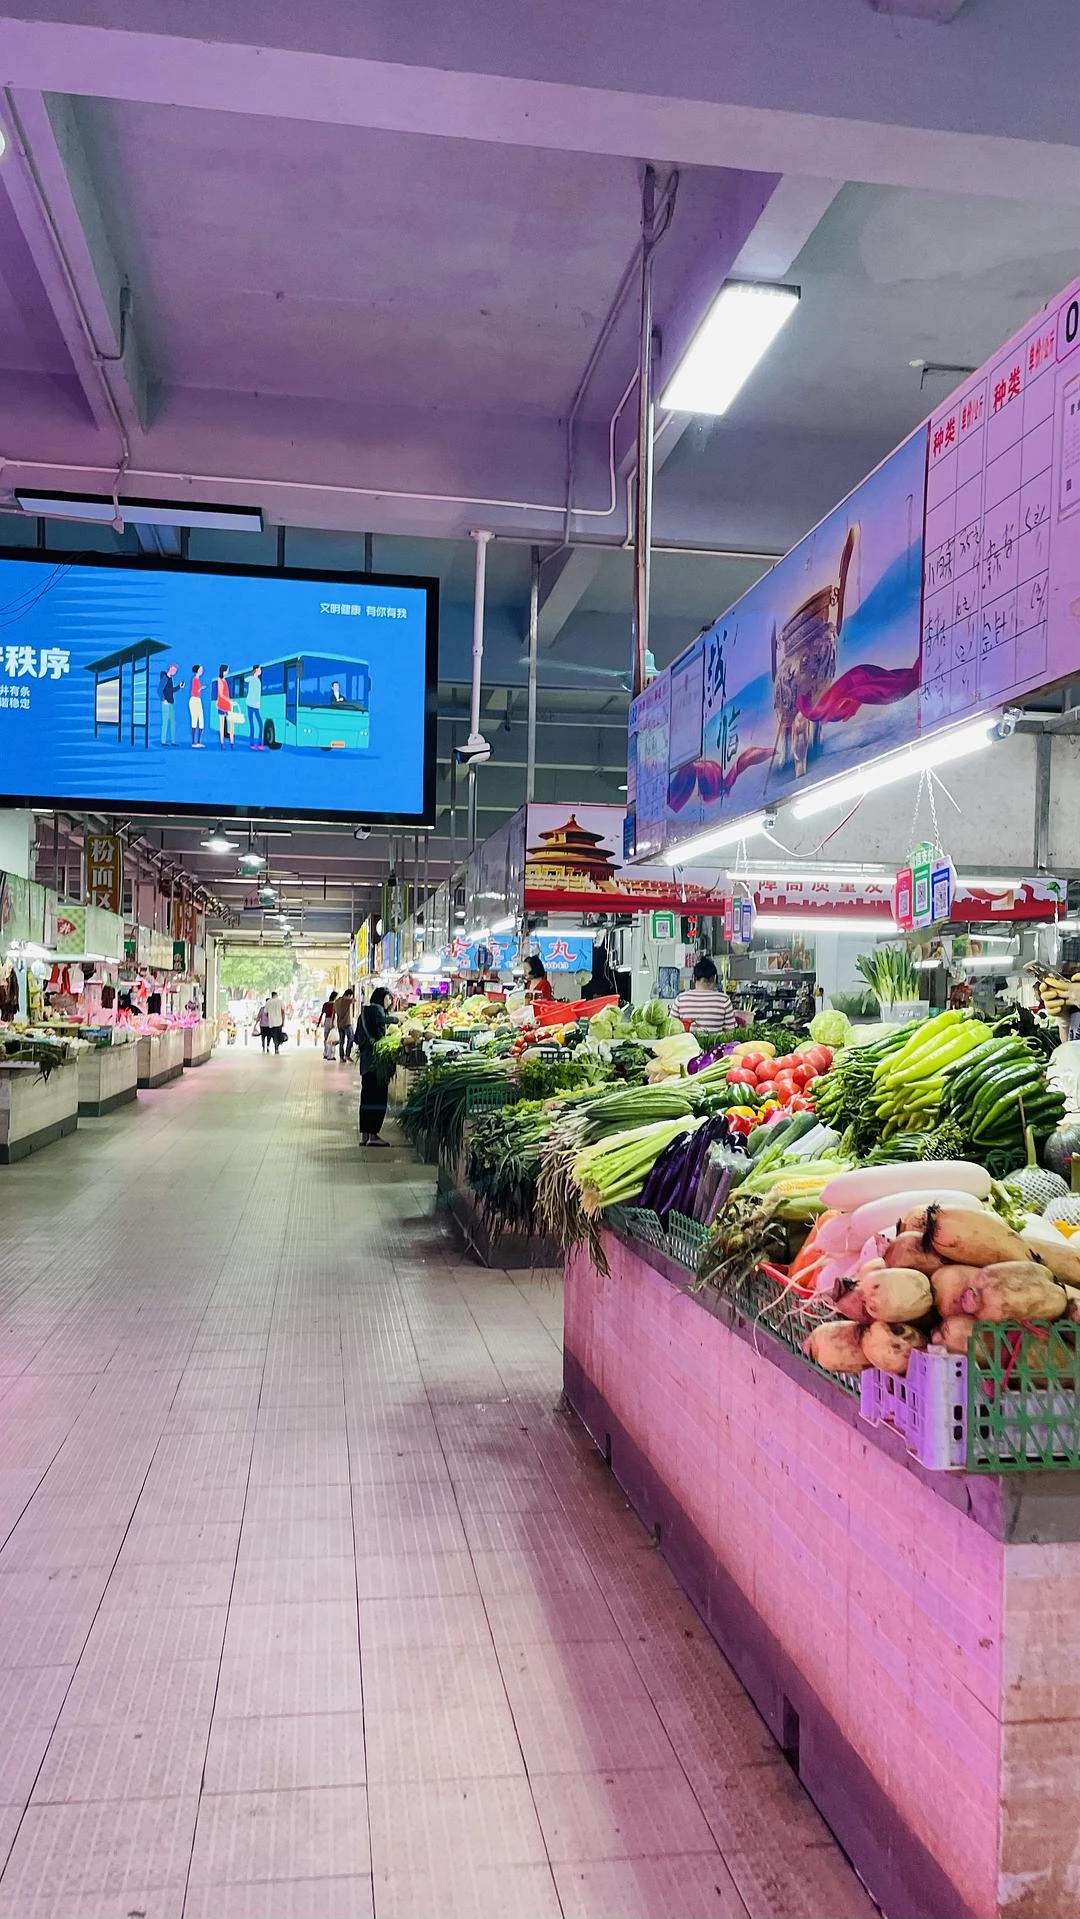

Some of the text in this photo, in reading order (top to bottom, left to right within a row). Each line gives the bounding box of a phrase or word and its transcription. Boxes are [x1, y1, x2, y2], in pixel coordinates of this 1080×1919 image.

[993, 366, 1020, 412] 种类
[933, 417, 955, 457] 种类
[320, 603, 407, 619] 文明健康 有你有我
[0, 646, 70, 680] 秩序
[91, 839, 115, 909] 粉面区
